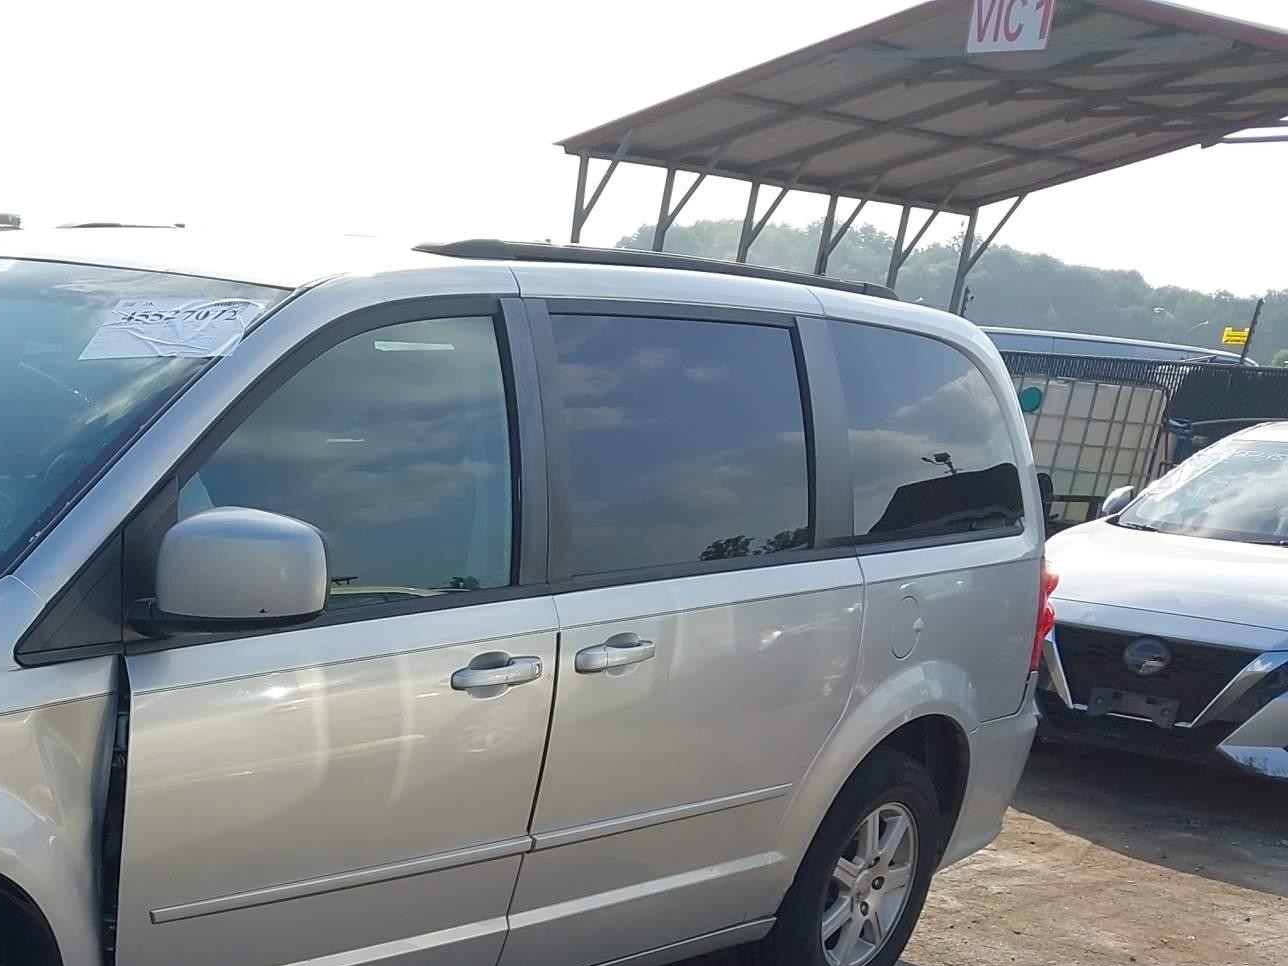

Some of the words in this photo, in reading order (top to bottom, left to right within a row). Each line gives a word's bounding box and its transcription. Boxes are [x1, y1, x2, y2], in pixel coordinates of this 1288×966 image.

[977, 0, 1028, 42] VIC
[1035, 0, 1053, 40] 1
[121, 308, 238, 323] 45527072
